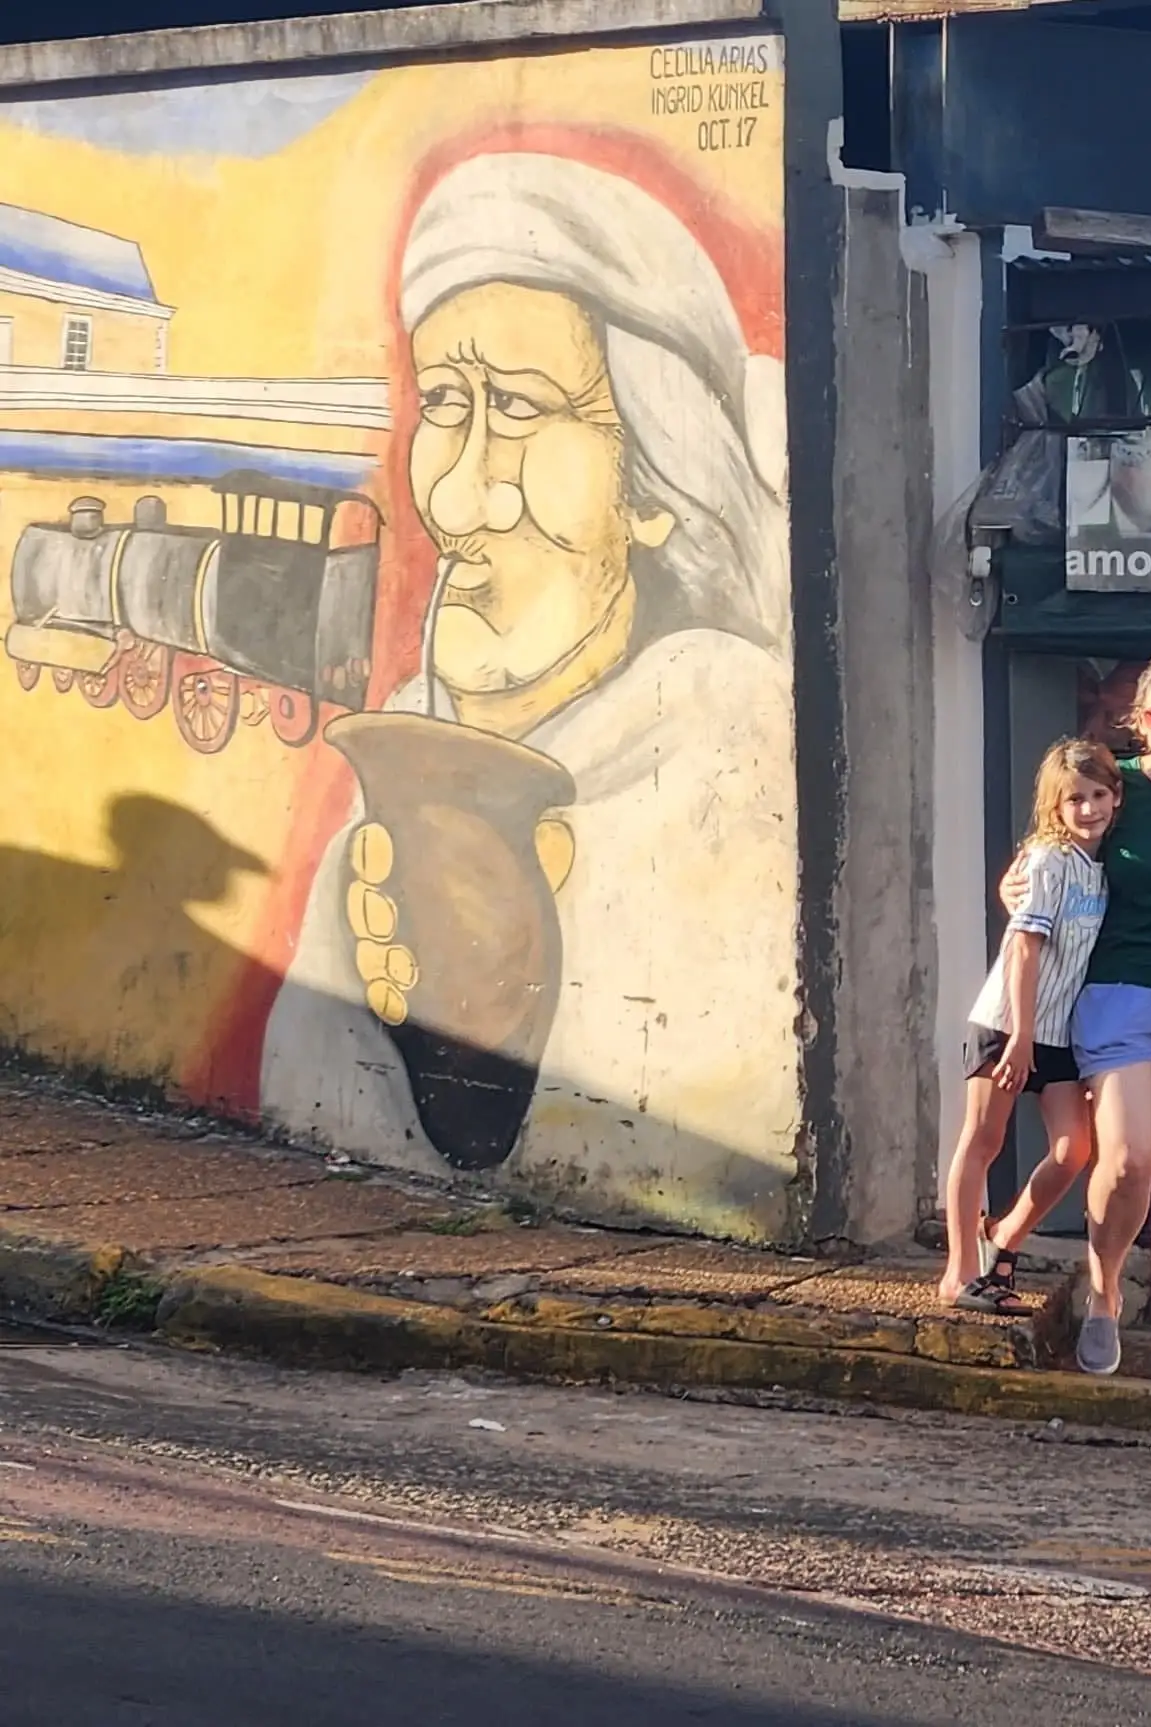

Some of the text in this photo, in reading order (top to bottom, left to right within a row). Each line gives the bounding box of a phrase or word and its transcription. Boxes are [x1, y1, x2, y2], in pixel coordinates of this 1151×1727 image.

[650, 44, 769, 79] CECILIA ARIAS
[652, 81, 769, 115] INGRID KUNKEL
[735, 116, 758, 147] 17
